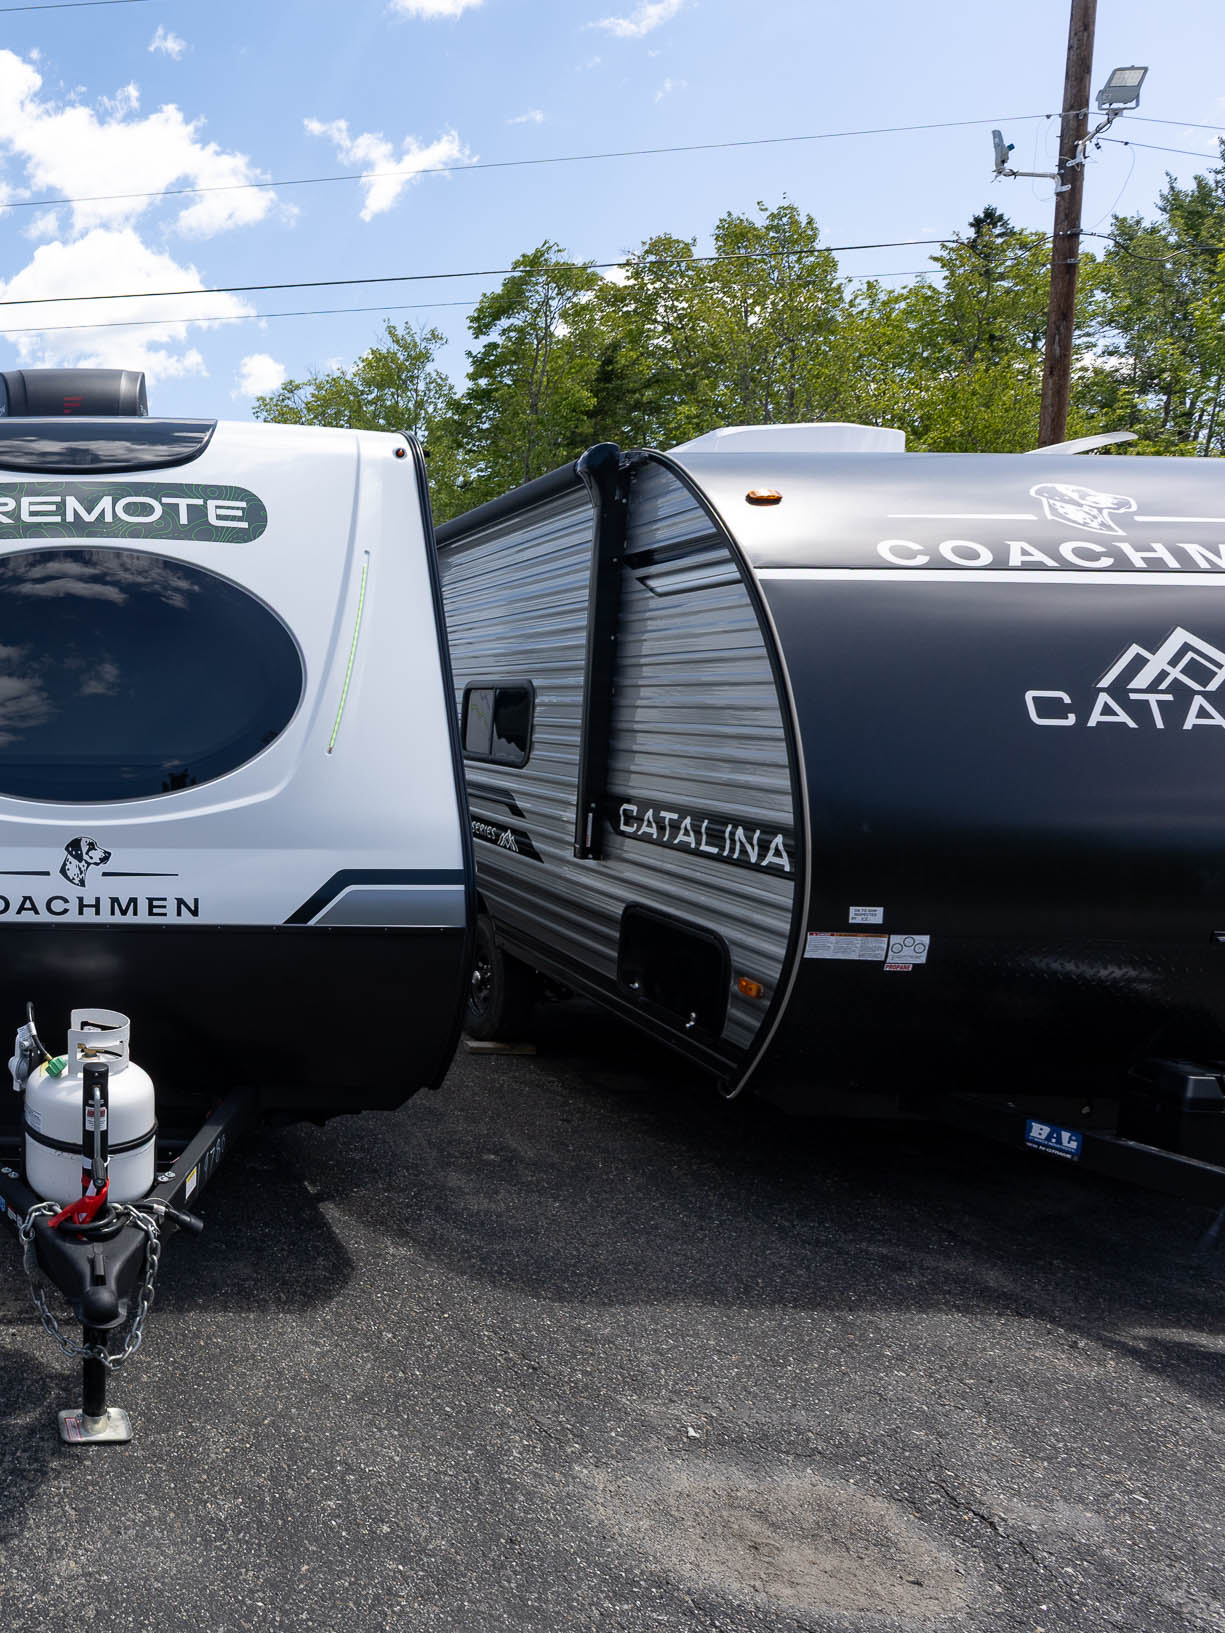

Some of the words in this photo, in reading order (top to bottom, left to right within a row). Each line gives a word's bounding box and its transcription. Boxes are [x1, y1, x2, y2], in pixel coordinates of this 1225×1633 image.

[1024, 690, 1225, 730] CATA
[471, 820, 496, 840] SERIES
[619, 803, 791, 873] CATALINA
[1029, 1121, 1078, 1150] BAL
